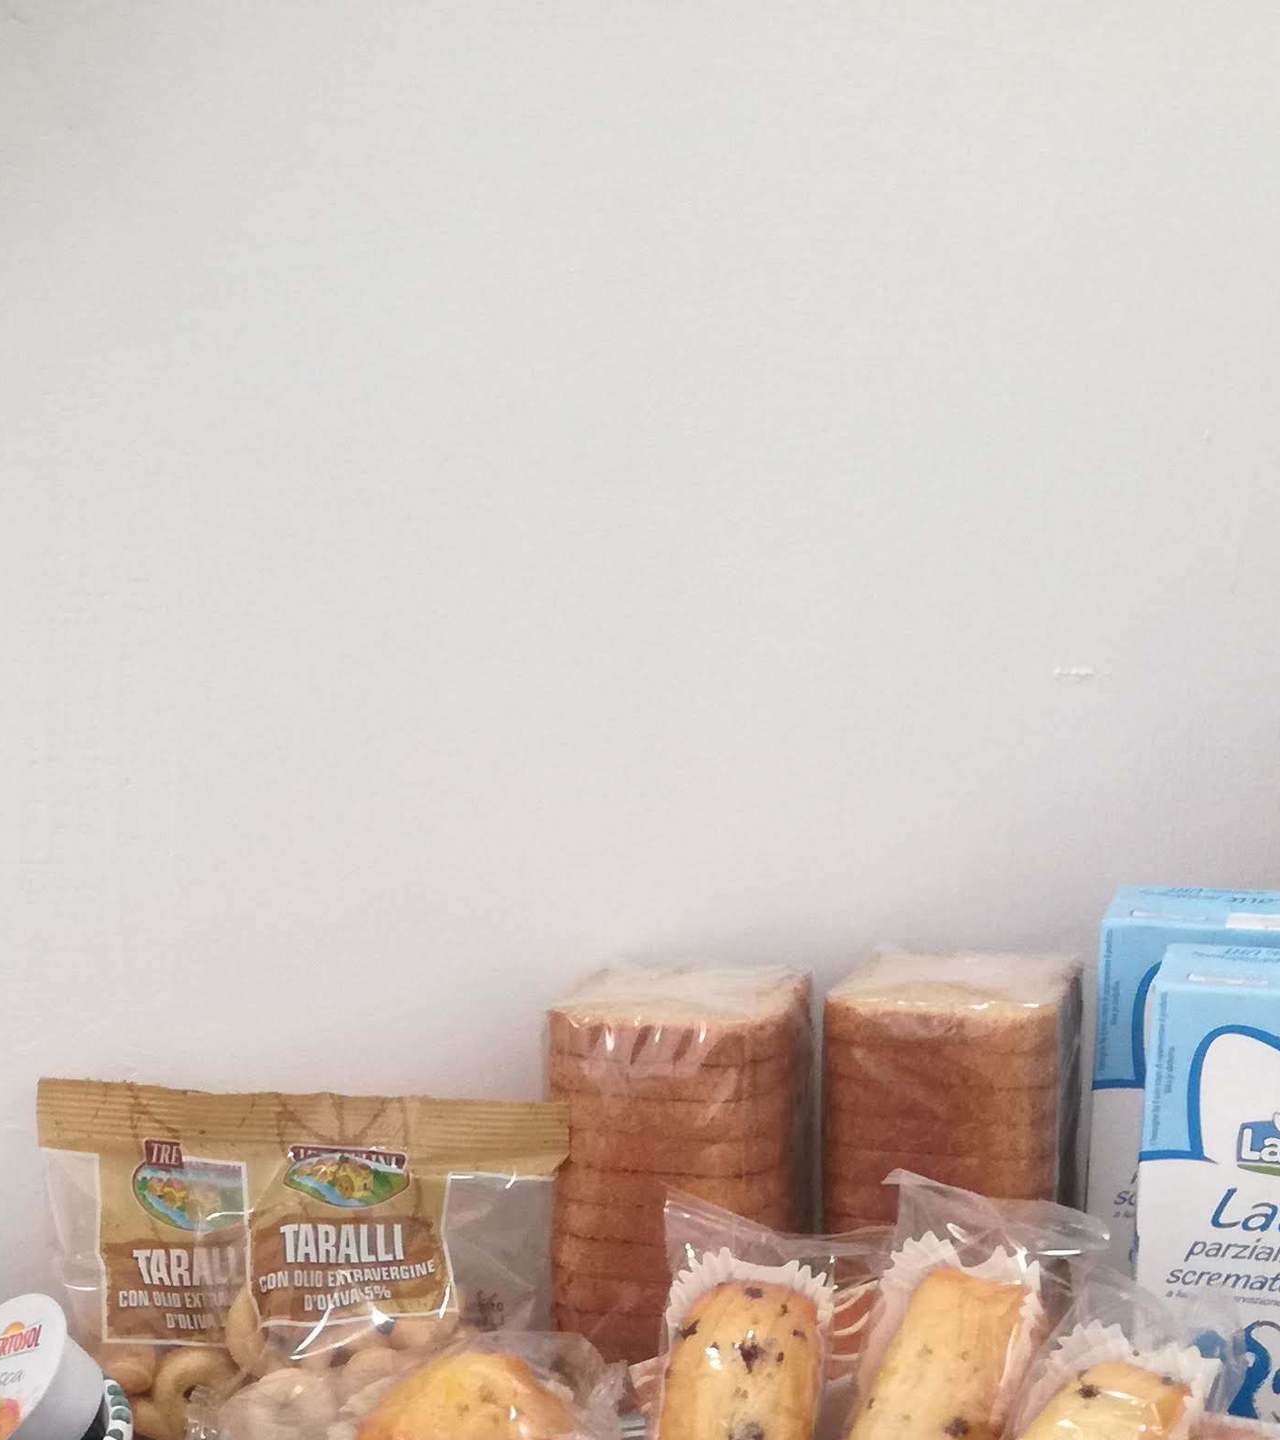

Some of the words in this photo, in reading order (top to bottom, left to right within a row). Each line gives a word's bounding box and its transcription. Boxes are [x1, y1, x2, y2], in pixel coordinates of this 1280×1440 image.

[150, 1142, 182, 1164] TRE
[279, 1223, 405, 1265] TARALLI
[132, 1248, 245, 1288] TARALL
[258, 1270, 289, 1294] CON
[293, 1269, 322, 1288] OLIO
[327, 1258, 437, 1288] EXTRAVERGINE
[119, 1290, 150, 1308] CON
[152, 1291, 182, 1308] OLIO
